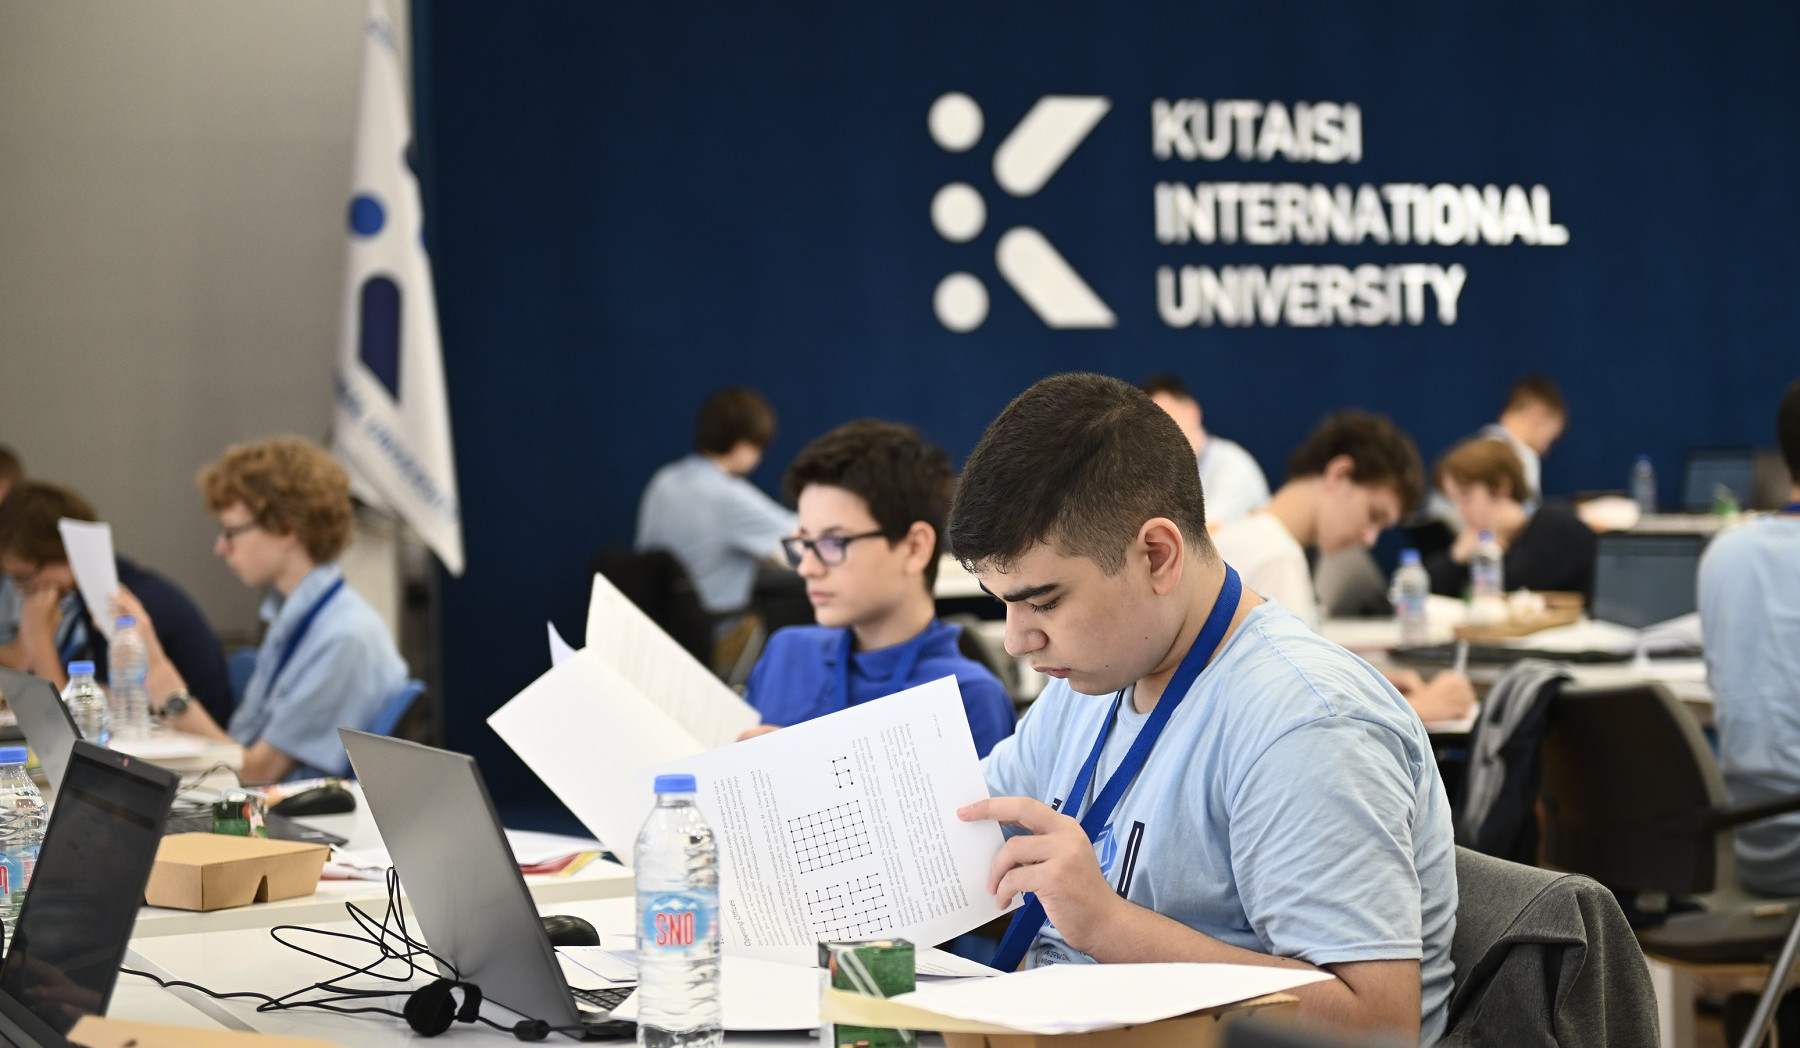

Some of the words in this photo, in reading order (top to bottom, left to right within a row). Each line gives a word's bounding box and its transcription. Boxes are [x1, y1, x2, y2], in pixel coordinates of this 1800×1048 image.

[1152, 99, 1363, 163] KUTAISI
[1154, 182, 1569, 245] INTERNATIONAL
[1157, 264, 1466, 328] UNIVERSITY
[655, 911, 695, 947] SNO
[729, 899, 740, 920] Offices
[737, 921, 751, 947] Opening
